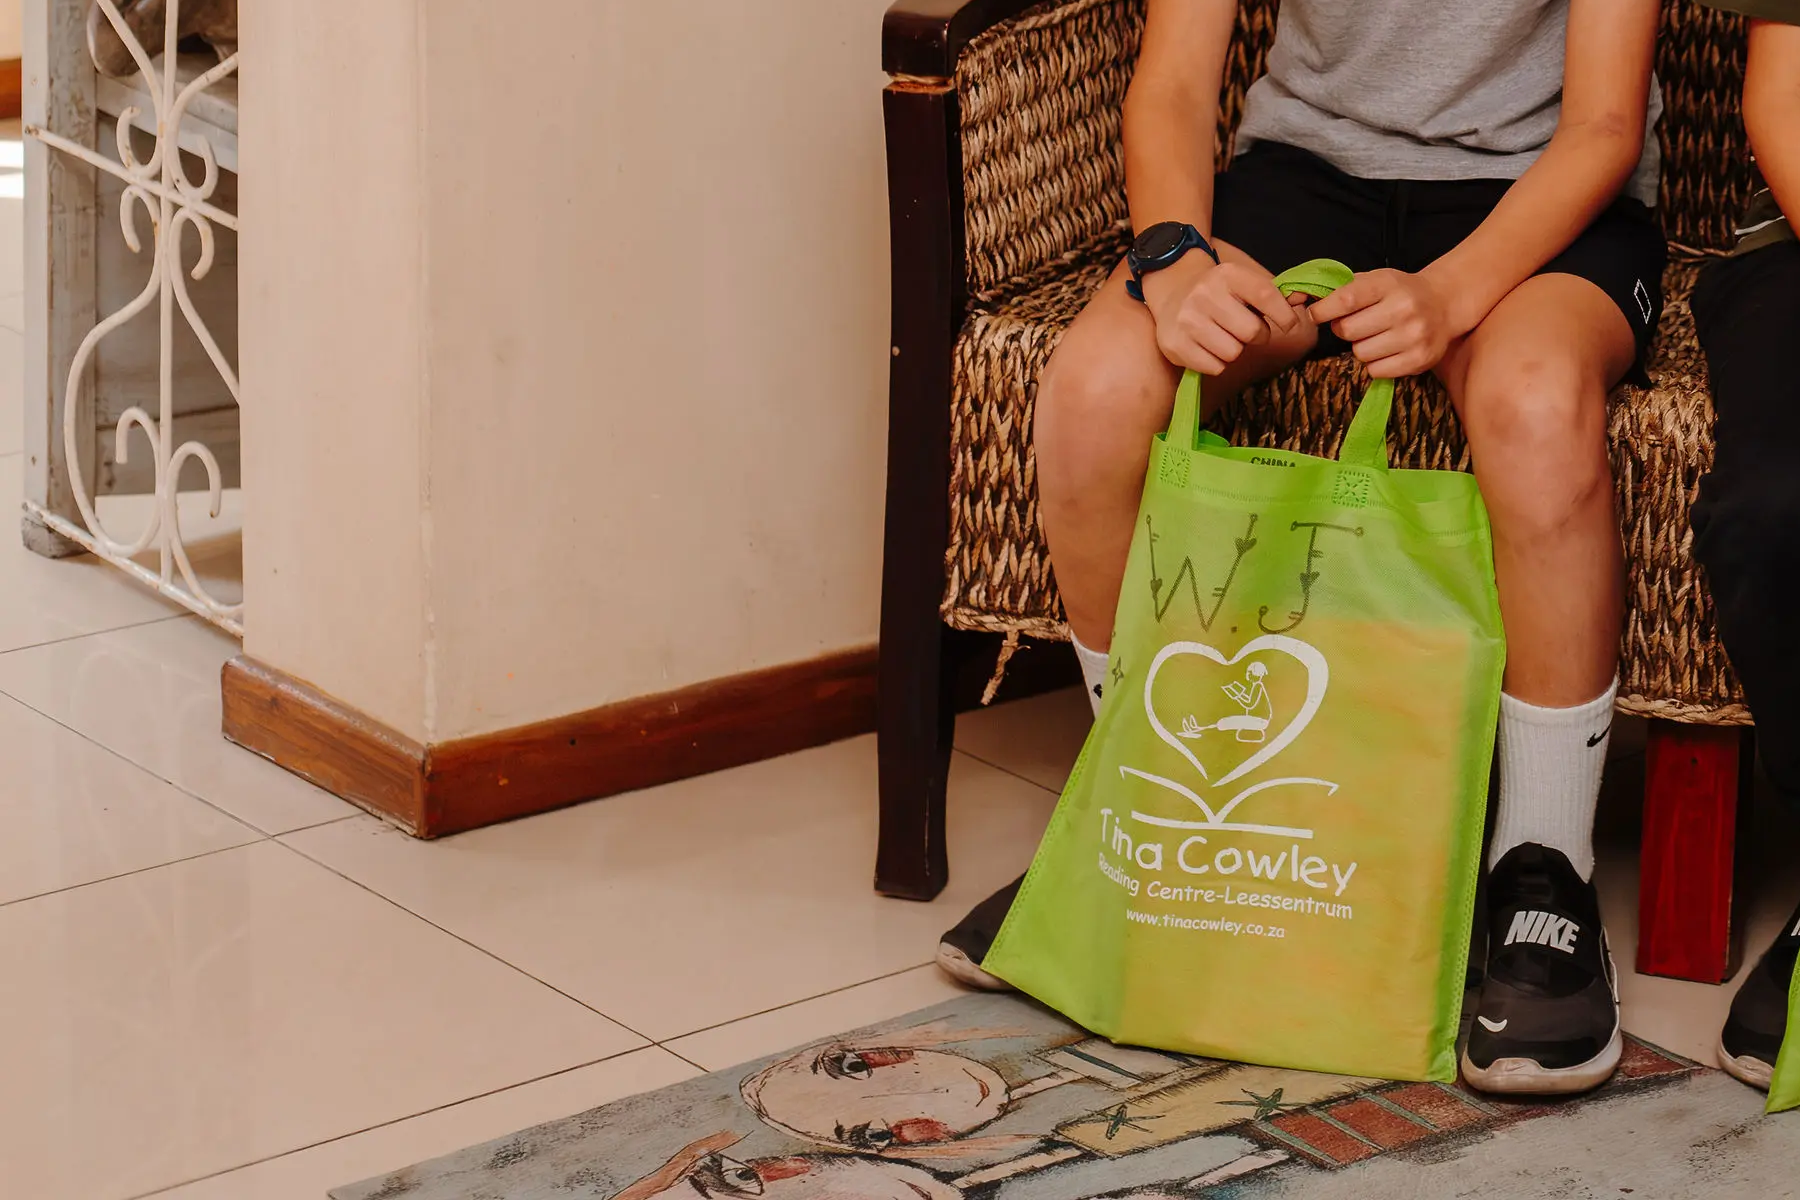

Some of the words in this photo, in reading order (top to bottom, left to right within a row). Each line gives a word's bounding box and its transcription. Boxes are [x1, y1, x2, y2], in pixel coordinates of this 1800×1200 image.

[1100, 807, 1163, 871] Tina
[1177, 835, 1358, 897] Cowley
[1147, 880, 1353, 920] Centre-Leessentrum
[1126, 907, 1286, 939] www.tinacowley.co.za
[1504, 910, 1580, 954] NIKE
